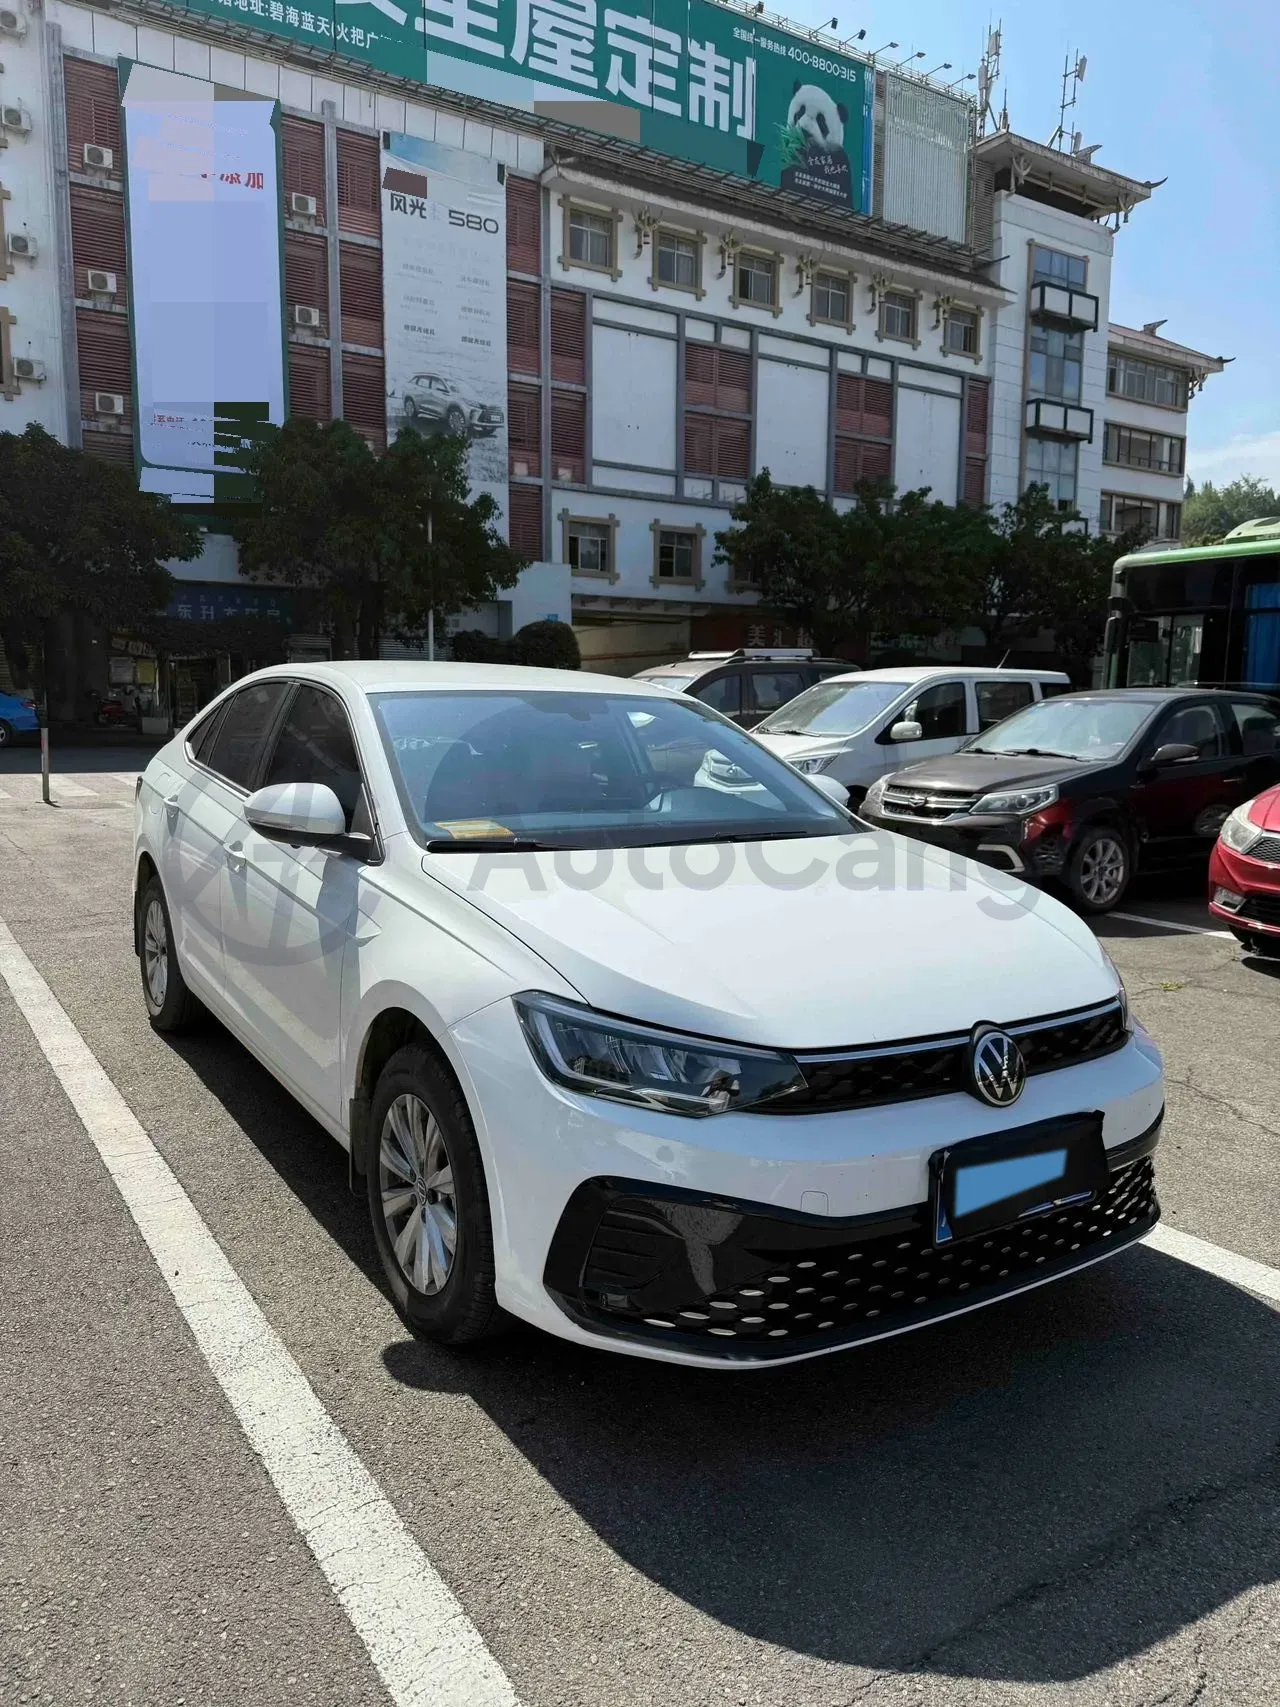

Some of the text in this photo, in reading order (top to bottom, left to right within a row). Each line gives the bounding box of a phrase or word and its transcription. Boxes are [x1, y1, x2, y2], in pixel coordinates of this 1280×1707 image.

[218, 0, 396, 49] 地址:碧海蓝天(火把广
[335, 0, 757, 141] 全屋定制
[787, 46, 857, 82] 400-8800-315
[390, 192, 499, 234] 风光 580
